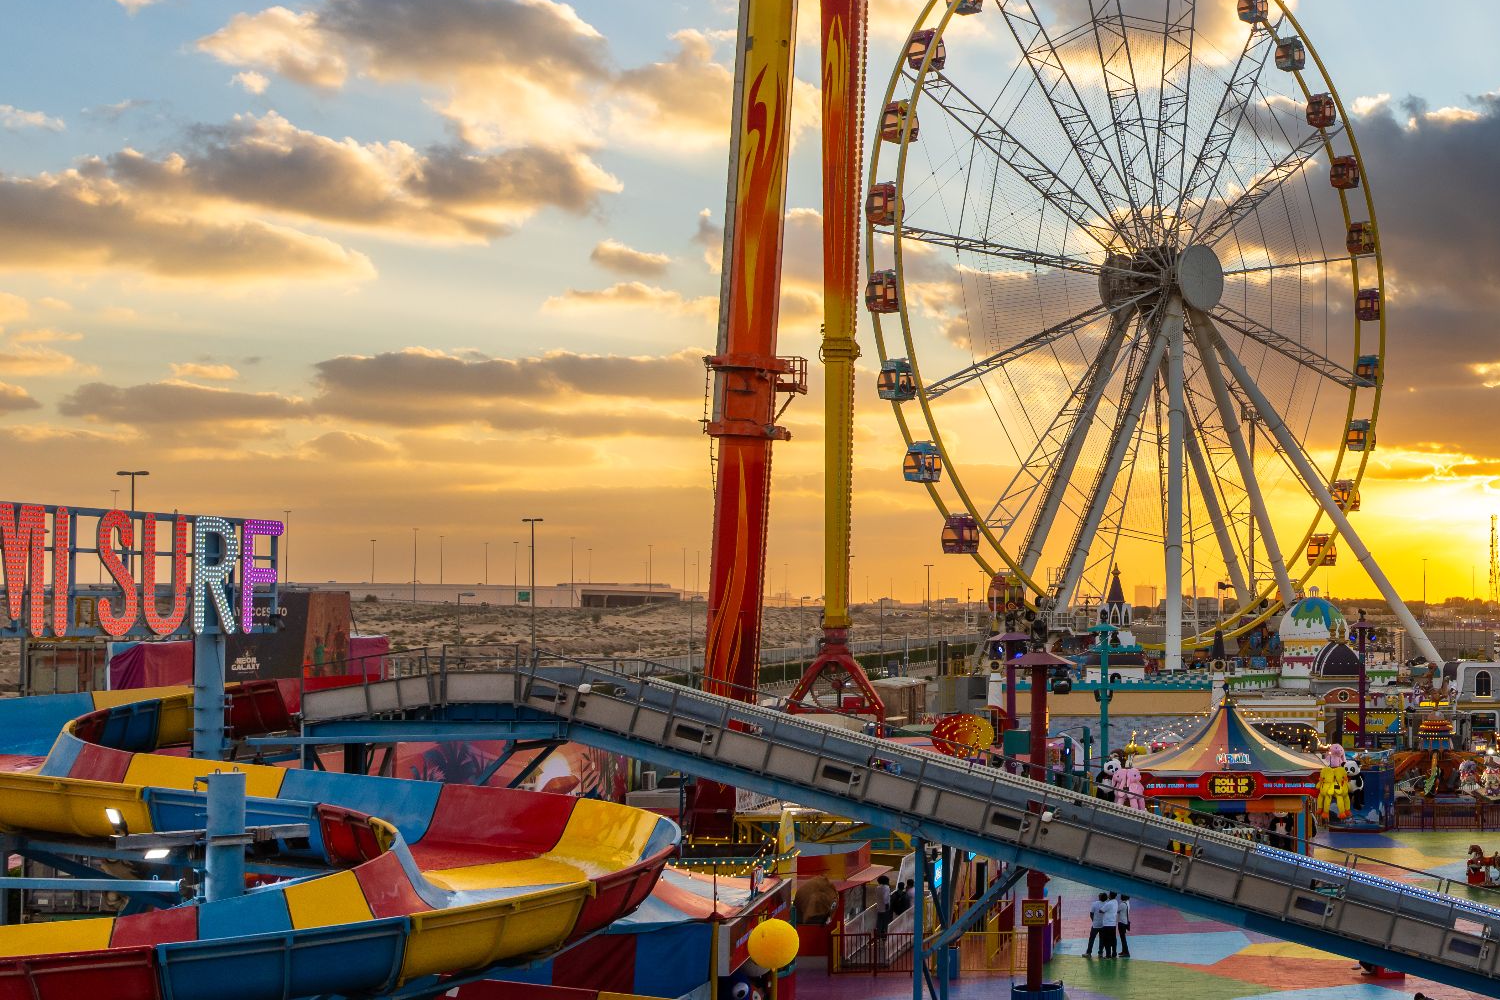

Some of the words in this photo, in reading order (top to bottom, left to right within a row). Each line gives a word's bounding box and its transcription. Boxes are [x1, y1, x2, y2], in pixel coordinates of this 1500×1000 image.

[97, 509, 284, 635] SURF
[1214, 778, 1235, 786] ROLL
[1237, 778, 1248, 786] UP
[1214, 786, 1235, 794] ROLL
[1237, 786, 1248, 794] UP
